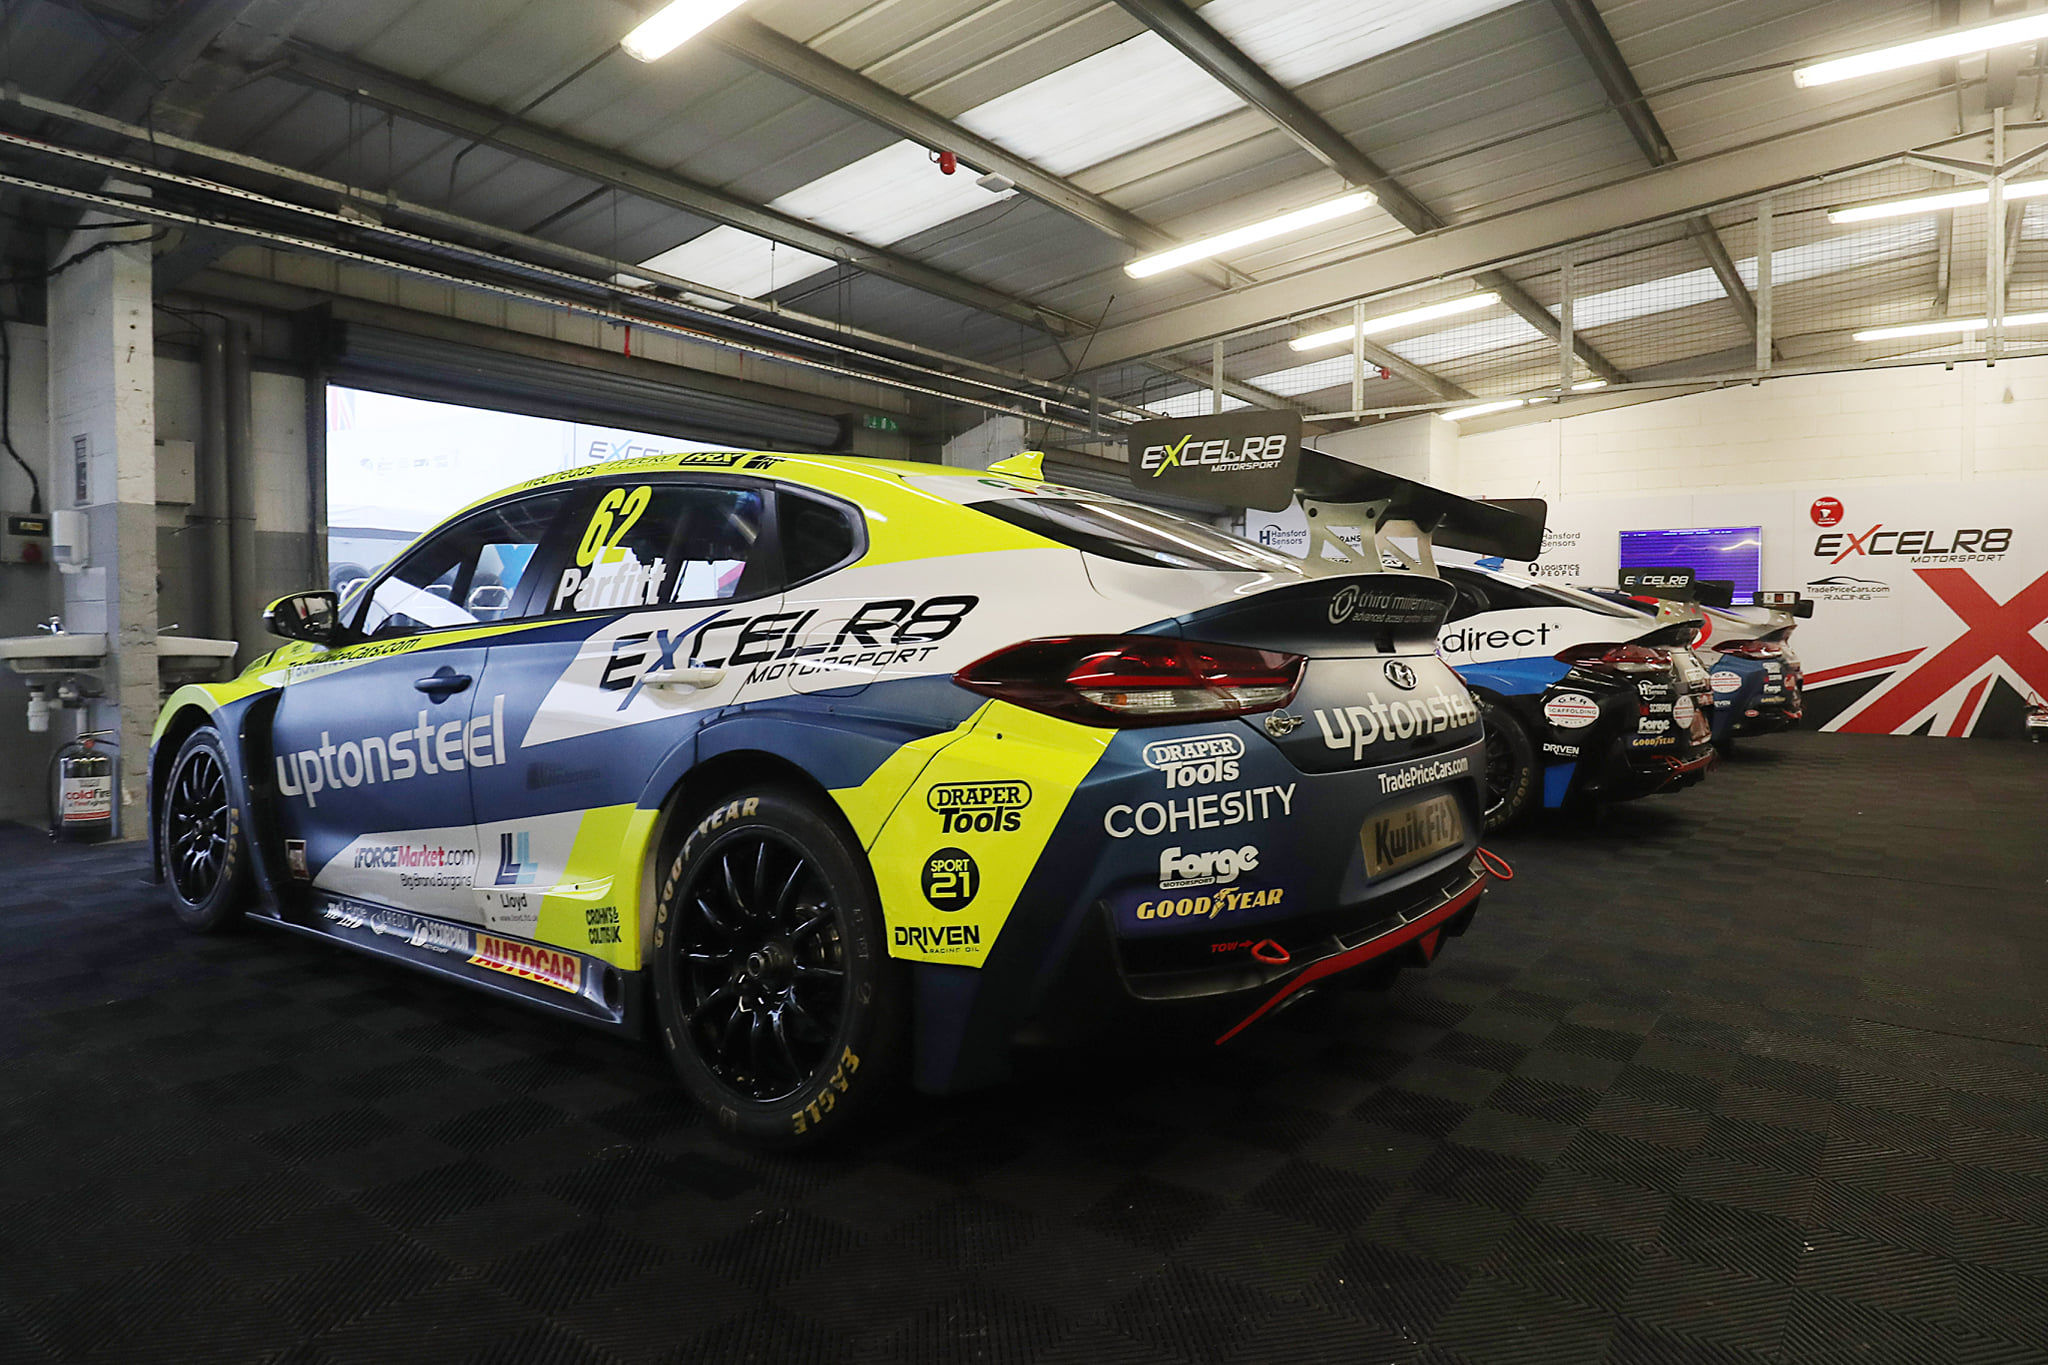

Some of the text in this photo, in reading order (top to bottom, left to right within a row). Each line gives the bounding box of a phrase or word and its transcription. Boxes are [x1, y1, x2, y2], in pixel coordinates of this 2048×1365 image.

[1141, 434, 1287, 477] EXCELR8
[1211, 460, 1281, 473] MOTORSPORT
[577, 485, 652, 567] 62
[1814, 524, 2013, 564] EXCELR8
[1911, 554, 2006, 564] MOTORSPORT
[553, 557, 667, 610] Parfitt
[1807, 585, 1890, 594] TradePriceCars.com
[600, 594, 980, 695] EXCELR8
[1442, 623, 1550, 652] direct
[747, 646, 939, 685] MOTORSPORT
[276, 694, 506, 808] uptonsteel
[1153, 738, 1237, 765] DRAPER
[1543, 743, 1579, 755] DRIVEN
[1160, 757, 1239, 789] Tools
[1378, 757, 1468, 794] TradePriceCars.com
[937, 787, 1021, 806] DRAPER
[1104, 783, 1296, 838] COHESITY
[939, 806, 1021, 833] Tools
[930, 858, 970, 873] SPORT
[930, 871, 970, 898] 21
[500, 893, 528, 911] Lloyd
[895, 925, 980, 953] DRIVEN
[1212, 942, 1239, 953] TOW
[475, 937, 577, 987] AUTOCAR
[791, 1046, 860, 1134] EAGLE
